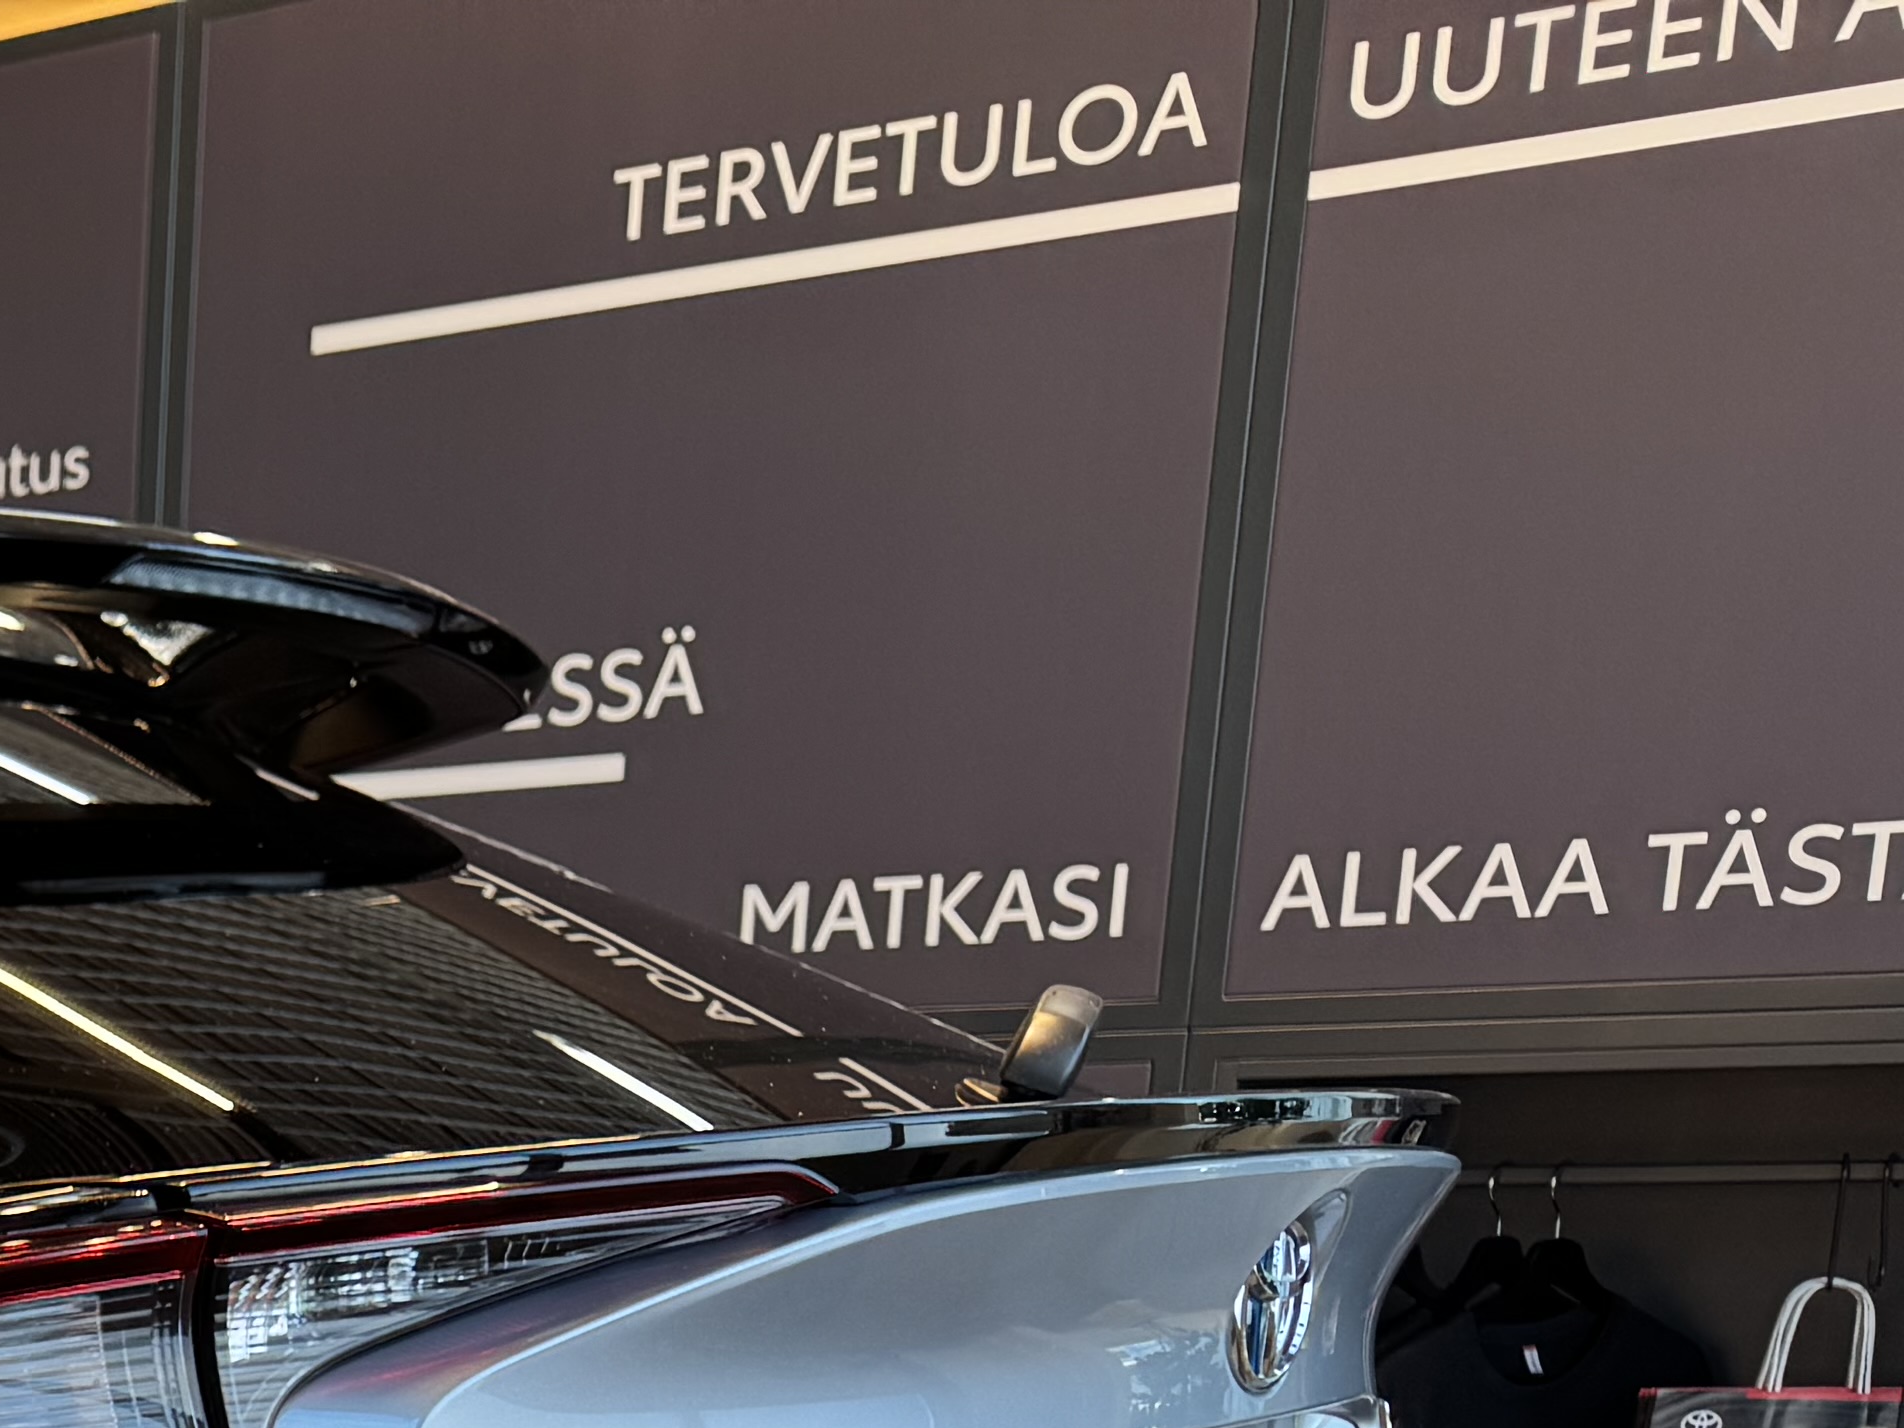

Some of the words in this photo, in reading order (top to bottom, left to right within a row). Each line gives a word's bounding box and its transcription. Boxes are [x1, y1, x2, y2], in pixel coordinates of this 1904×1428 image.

[1349, 0, 1799, 121] UUTEEN
[613, 71, 1209, 242] TERVETULOA
[502, 625, 705, 733] SSÄ
[739, 862, 1131, 955] MATKASI
[1259, 837, 1610, 934] ALKAA
[1647, 807, 1904, 912] TÄST
